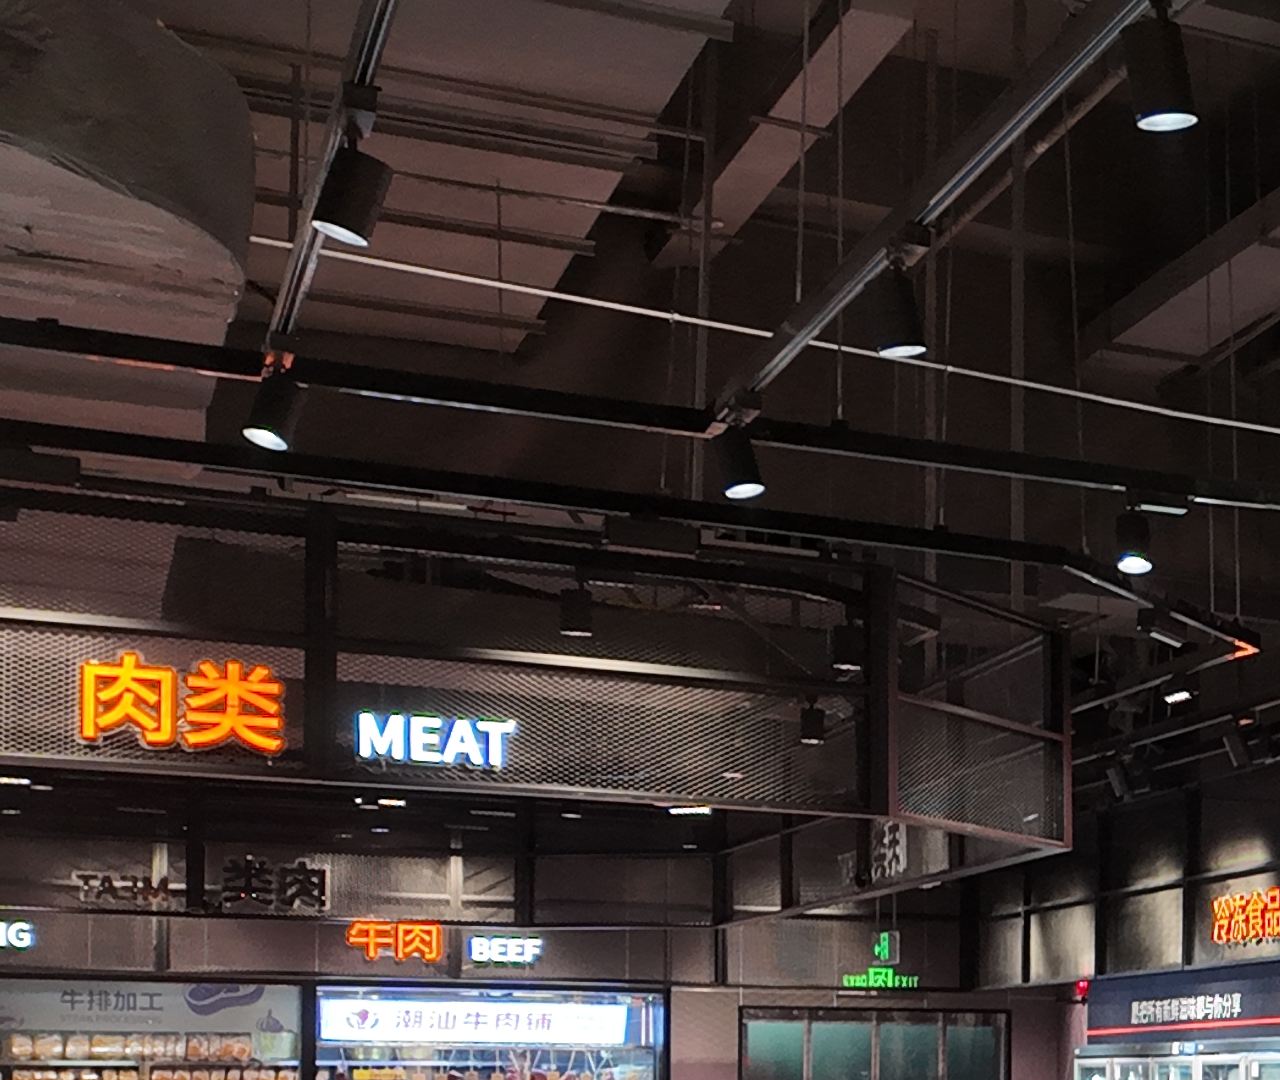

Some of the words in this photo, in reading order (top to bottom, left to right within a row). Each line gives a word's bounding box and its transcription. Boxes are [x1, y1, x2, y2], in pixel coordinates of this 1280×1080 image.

[80, 652, 284, 752] 肉类
[355, 711, 515, 767] MEAT
[347, 919, 442, 962] 牛肉
[470, 936, 543, 964] BEEF
[60, 989, 163, 1012] 牛排加工
